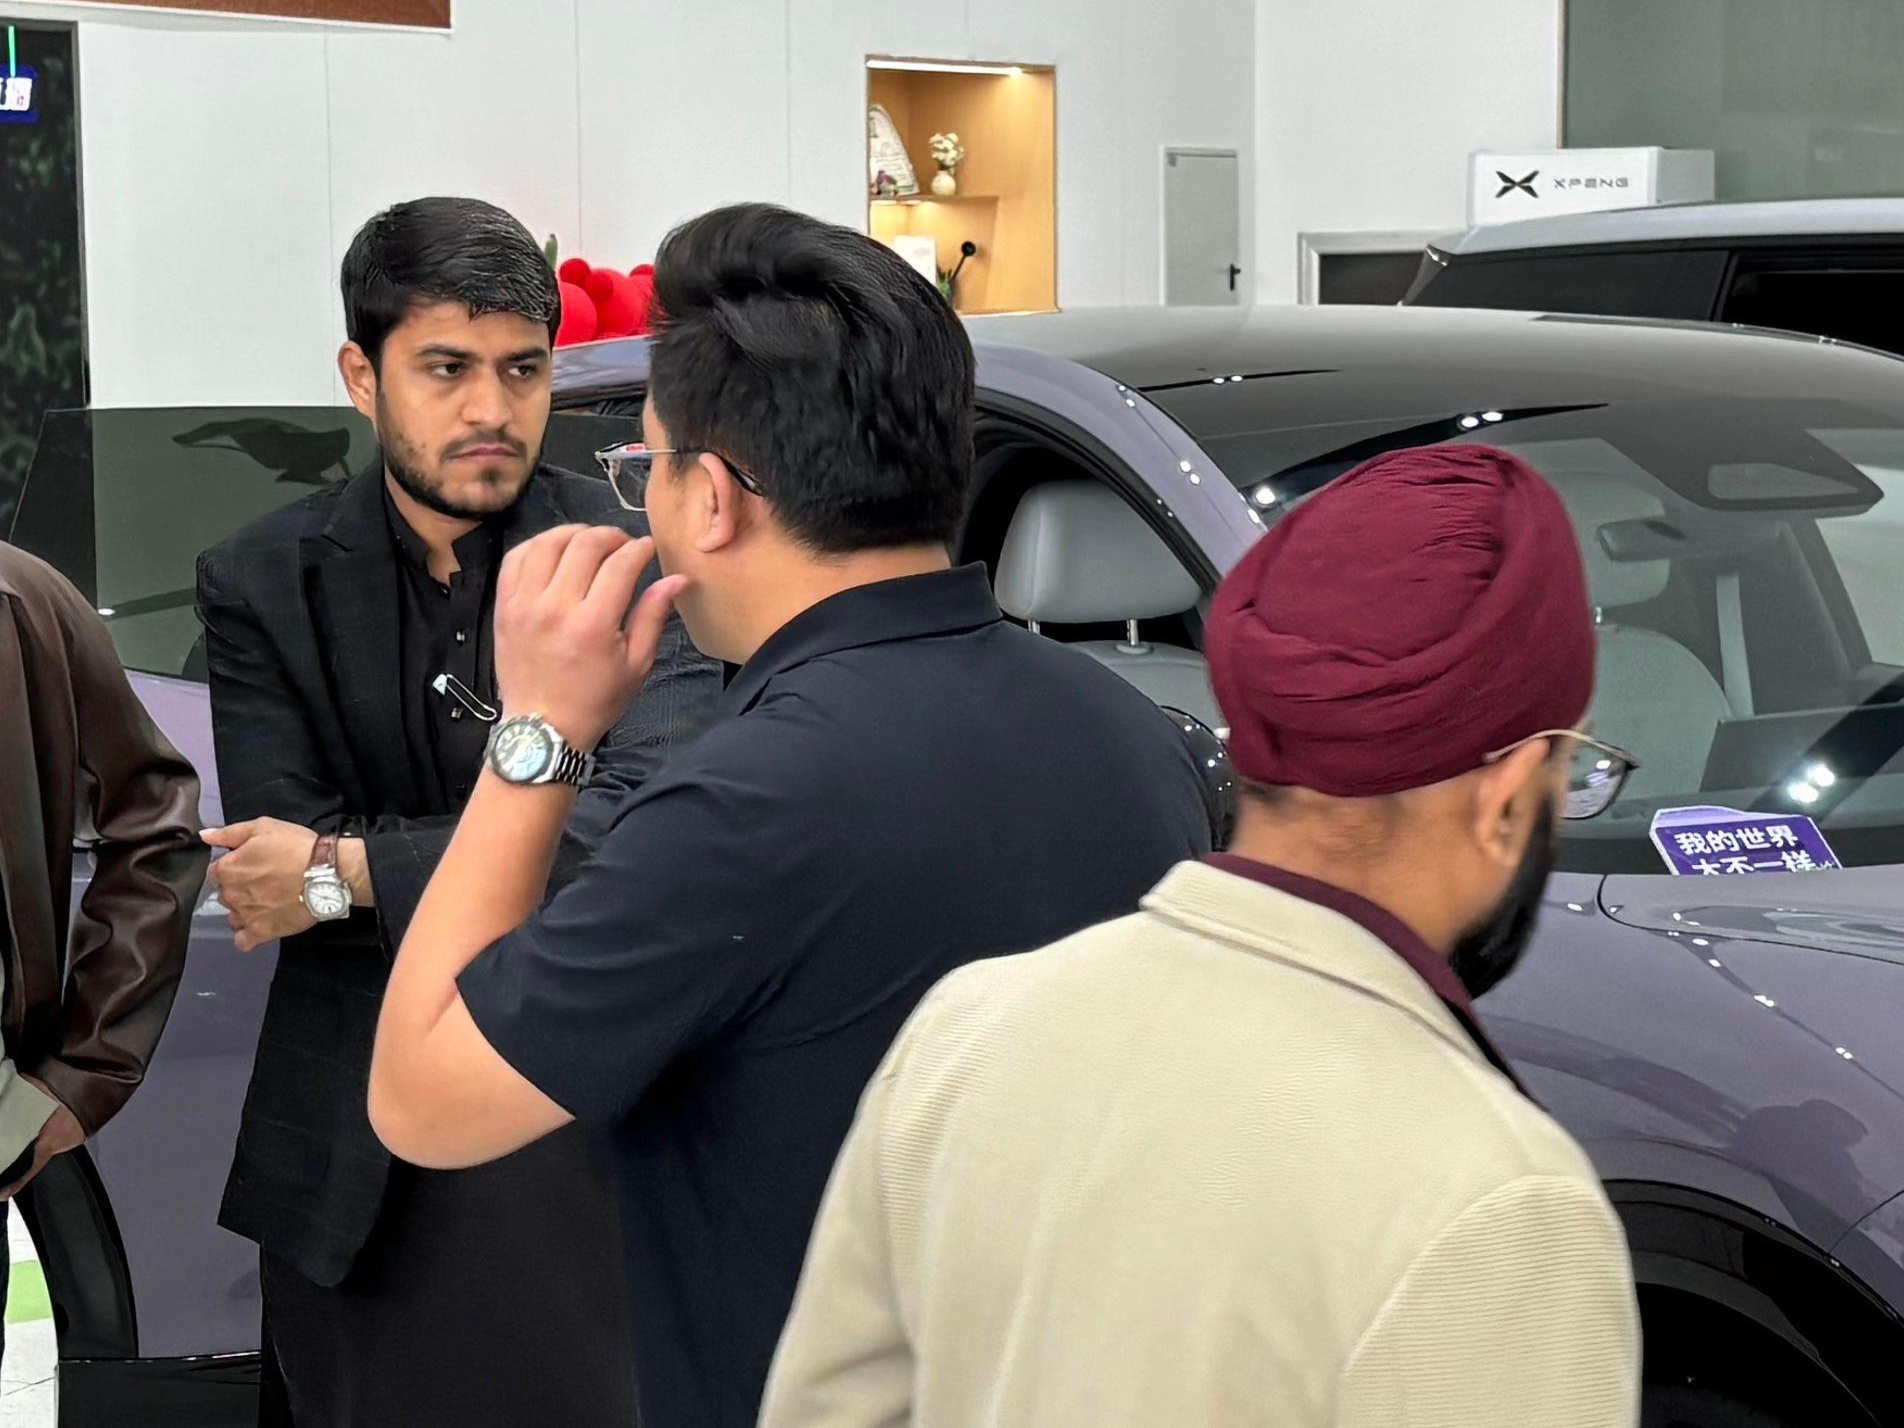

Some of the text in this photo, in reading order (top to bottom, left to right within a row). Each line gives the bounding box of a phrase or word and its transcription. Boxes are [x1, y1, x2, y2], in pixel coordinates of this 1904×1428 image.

[1553, 177, 1629, 189] XPENG
[1674, 824, 1799, 855] 我的世界
[1692, 850, 1816, 875] 大不一样
